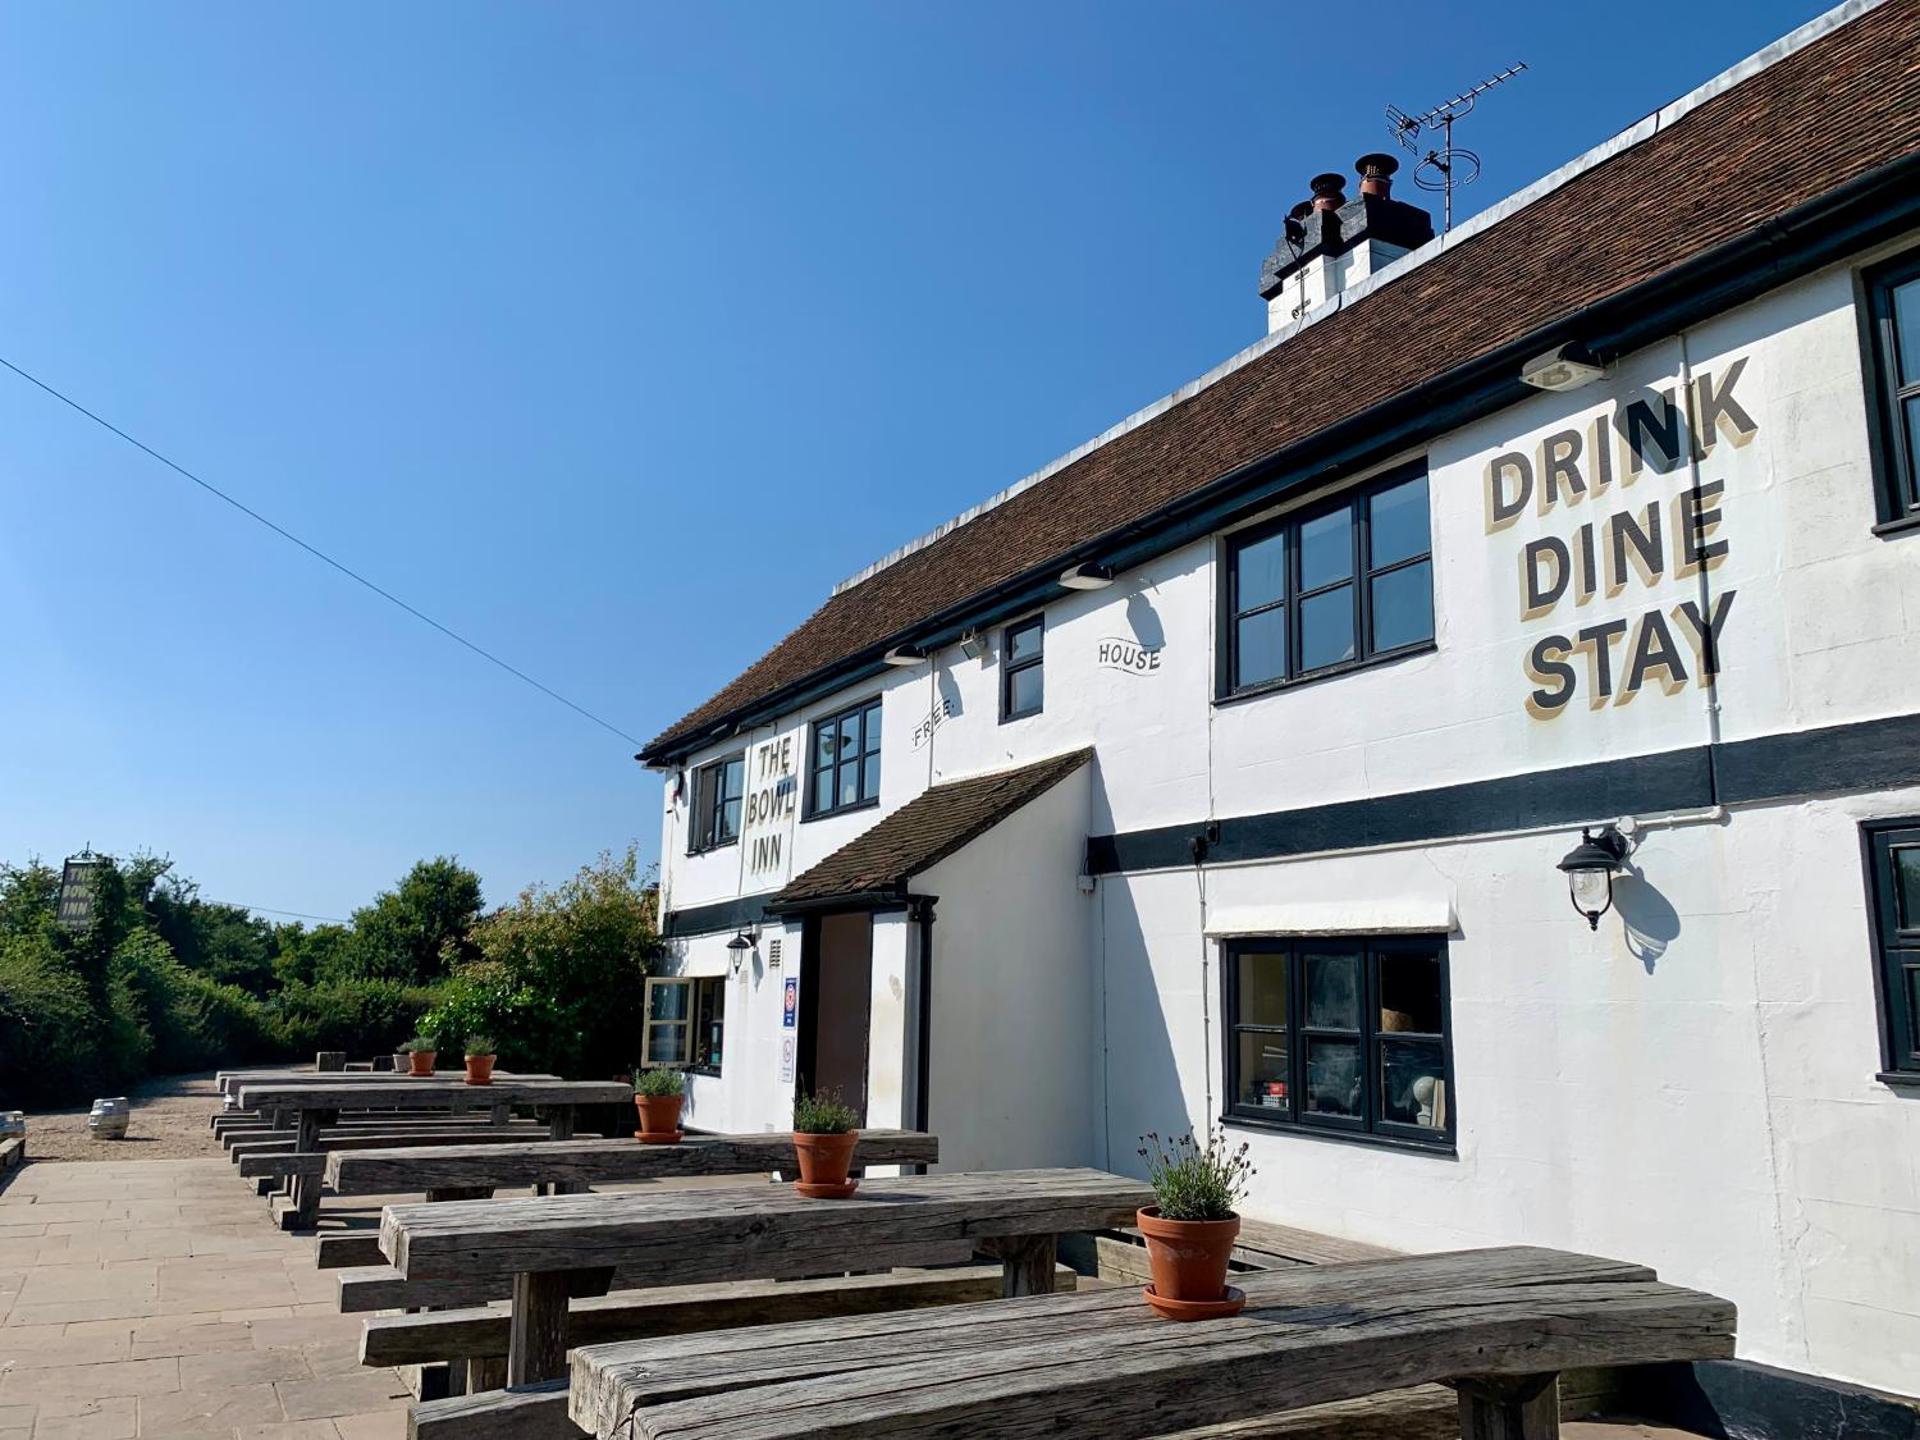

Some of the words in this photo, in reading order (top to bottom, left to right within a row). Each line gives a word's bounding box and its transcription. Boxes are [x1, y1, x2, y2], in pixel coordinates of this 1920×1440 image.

[1485, 355, 1758, 535] DRINK
[1518, 479, 1729, 622] DINE
[1099, 643, 1161, 670] HOUSE
[1523, 589, 1738, 721] STAY
[914, 699, 951, 747] FREE
[759, 736, 791, 778] THE
[748, 781, 795, 826] BOWL
[751, 833, 782, 873] INN
[62, 901, 88, 915] INN
